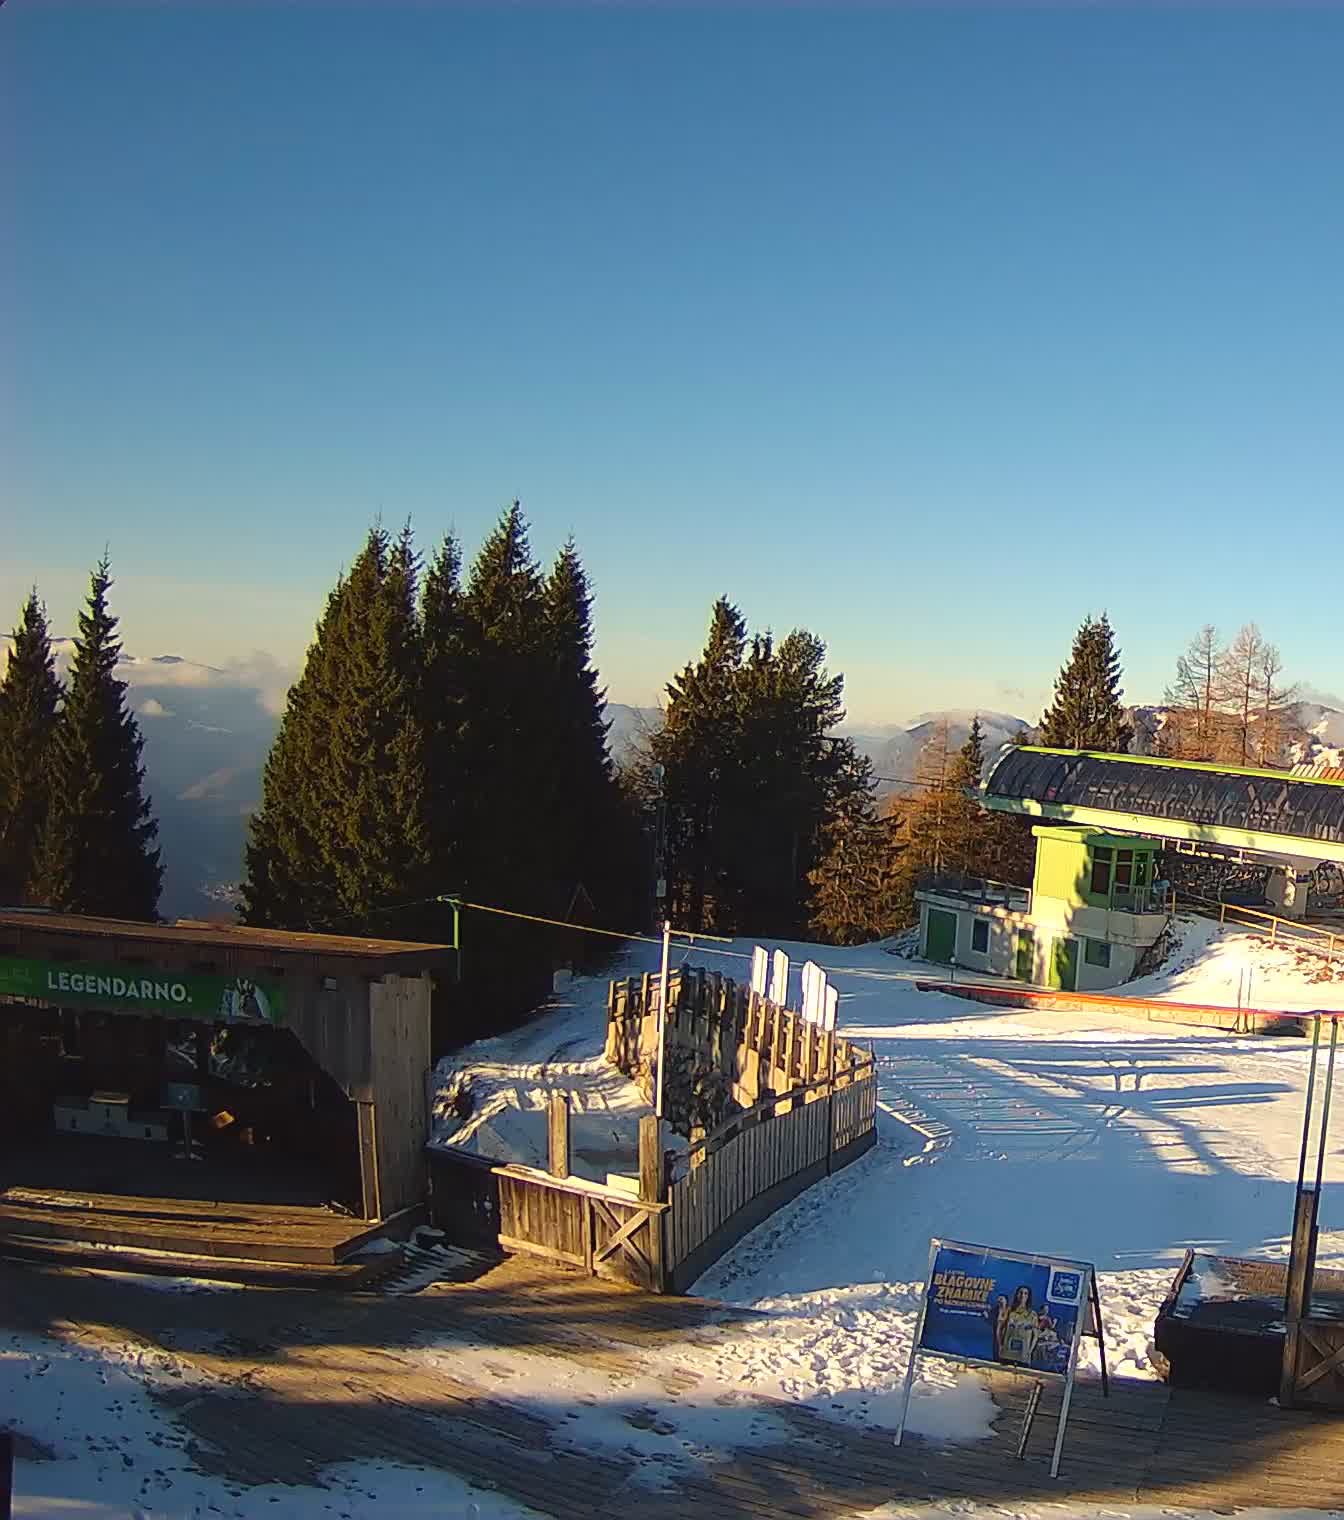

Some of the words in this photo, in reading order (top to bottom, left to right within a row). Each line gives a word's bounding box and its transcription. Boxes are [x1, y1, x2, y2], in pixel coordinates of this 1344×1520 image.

[47, 971, 192, 1003] LEGENDARNO.
[933, 1273, 997, 1291] BLAGOVNE
[936, 1286, 989, 1302] ZNAMKE
